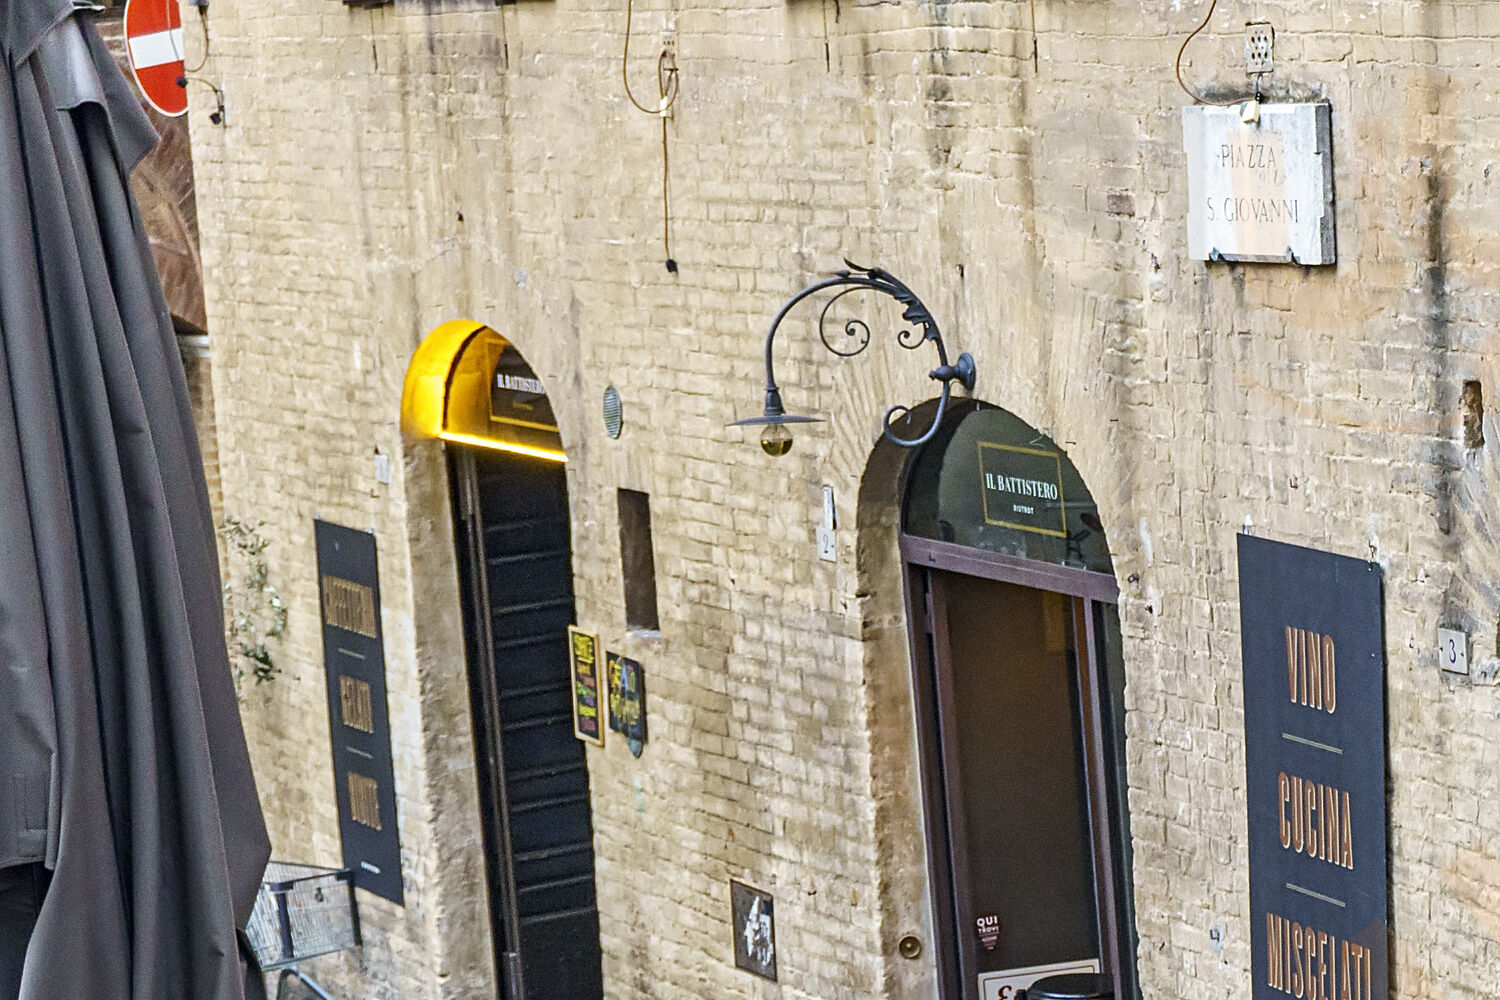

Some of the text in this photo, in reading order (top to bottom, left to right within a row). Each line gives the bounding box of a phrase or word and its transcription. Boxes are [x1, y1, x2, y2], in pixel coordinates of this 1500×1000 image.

[1221, 144, 1277, 168] PIAZZA
[1224, 198, 1299, 223] GIOVANNI
[985, 473, 1058, 500] IL BATTISTERO
[1449, 638, 1457, 664] 3
[1285, 625, 1338, 715] VINO
[1277, 770, 1354, 871] CUCINA
